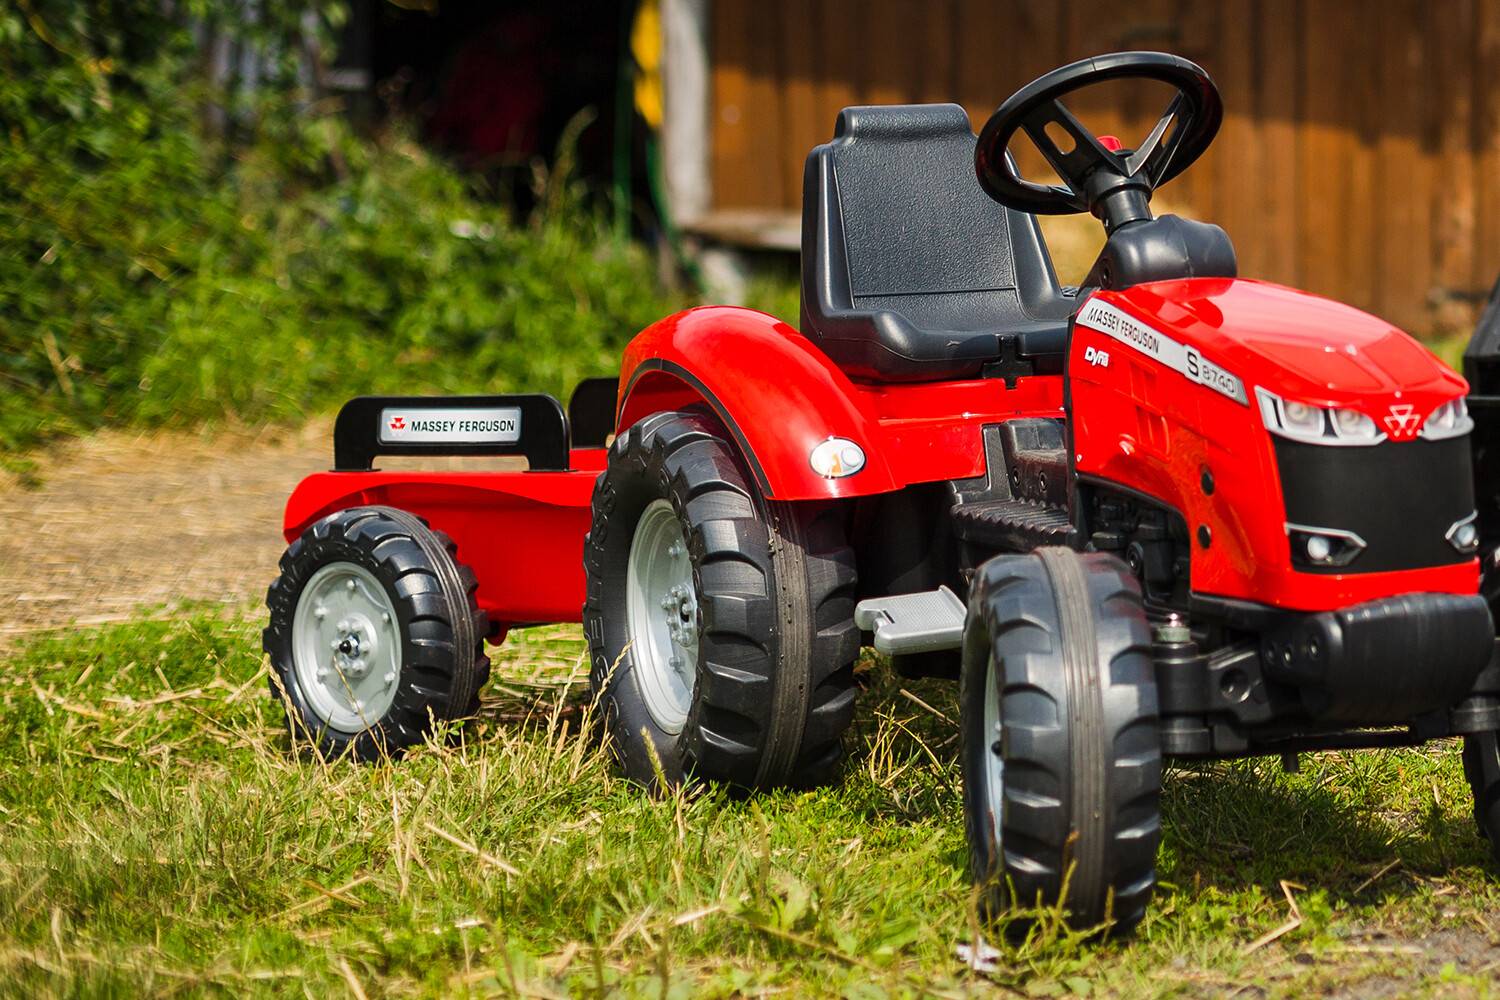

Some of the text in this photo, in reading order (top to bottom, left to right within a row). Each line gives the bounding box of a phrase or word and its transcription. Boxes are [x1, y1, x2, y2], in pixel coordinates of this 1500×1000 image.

[1087, 307, 1120, 331] MASSEY
[1120, 320, 1159, 354] FERGUSON
[1187, 351, 1199, 377] S
[410, 420, 515, 432] MASSEY FERGUSON
